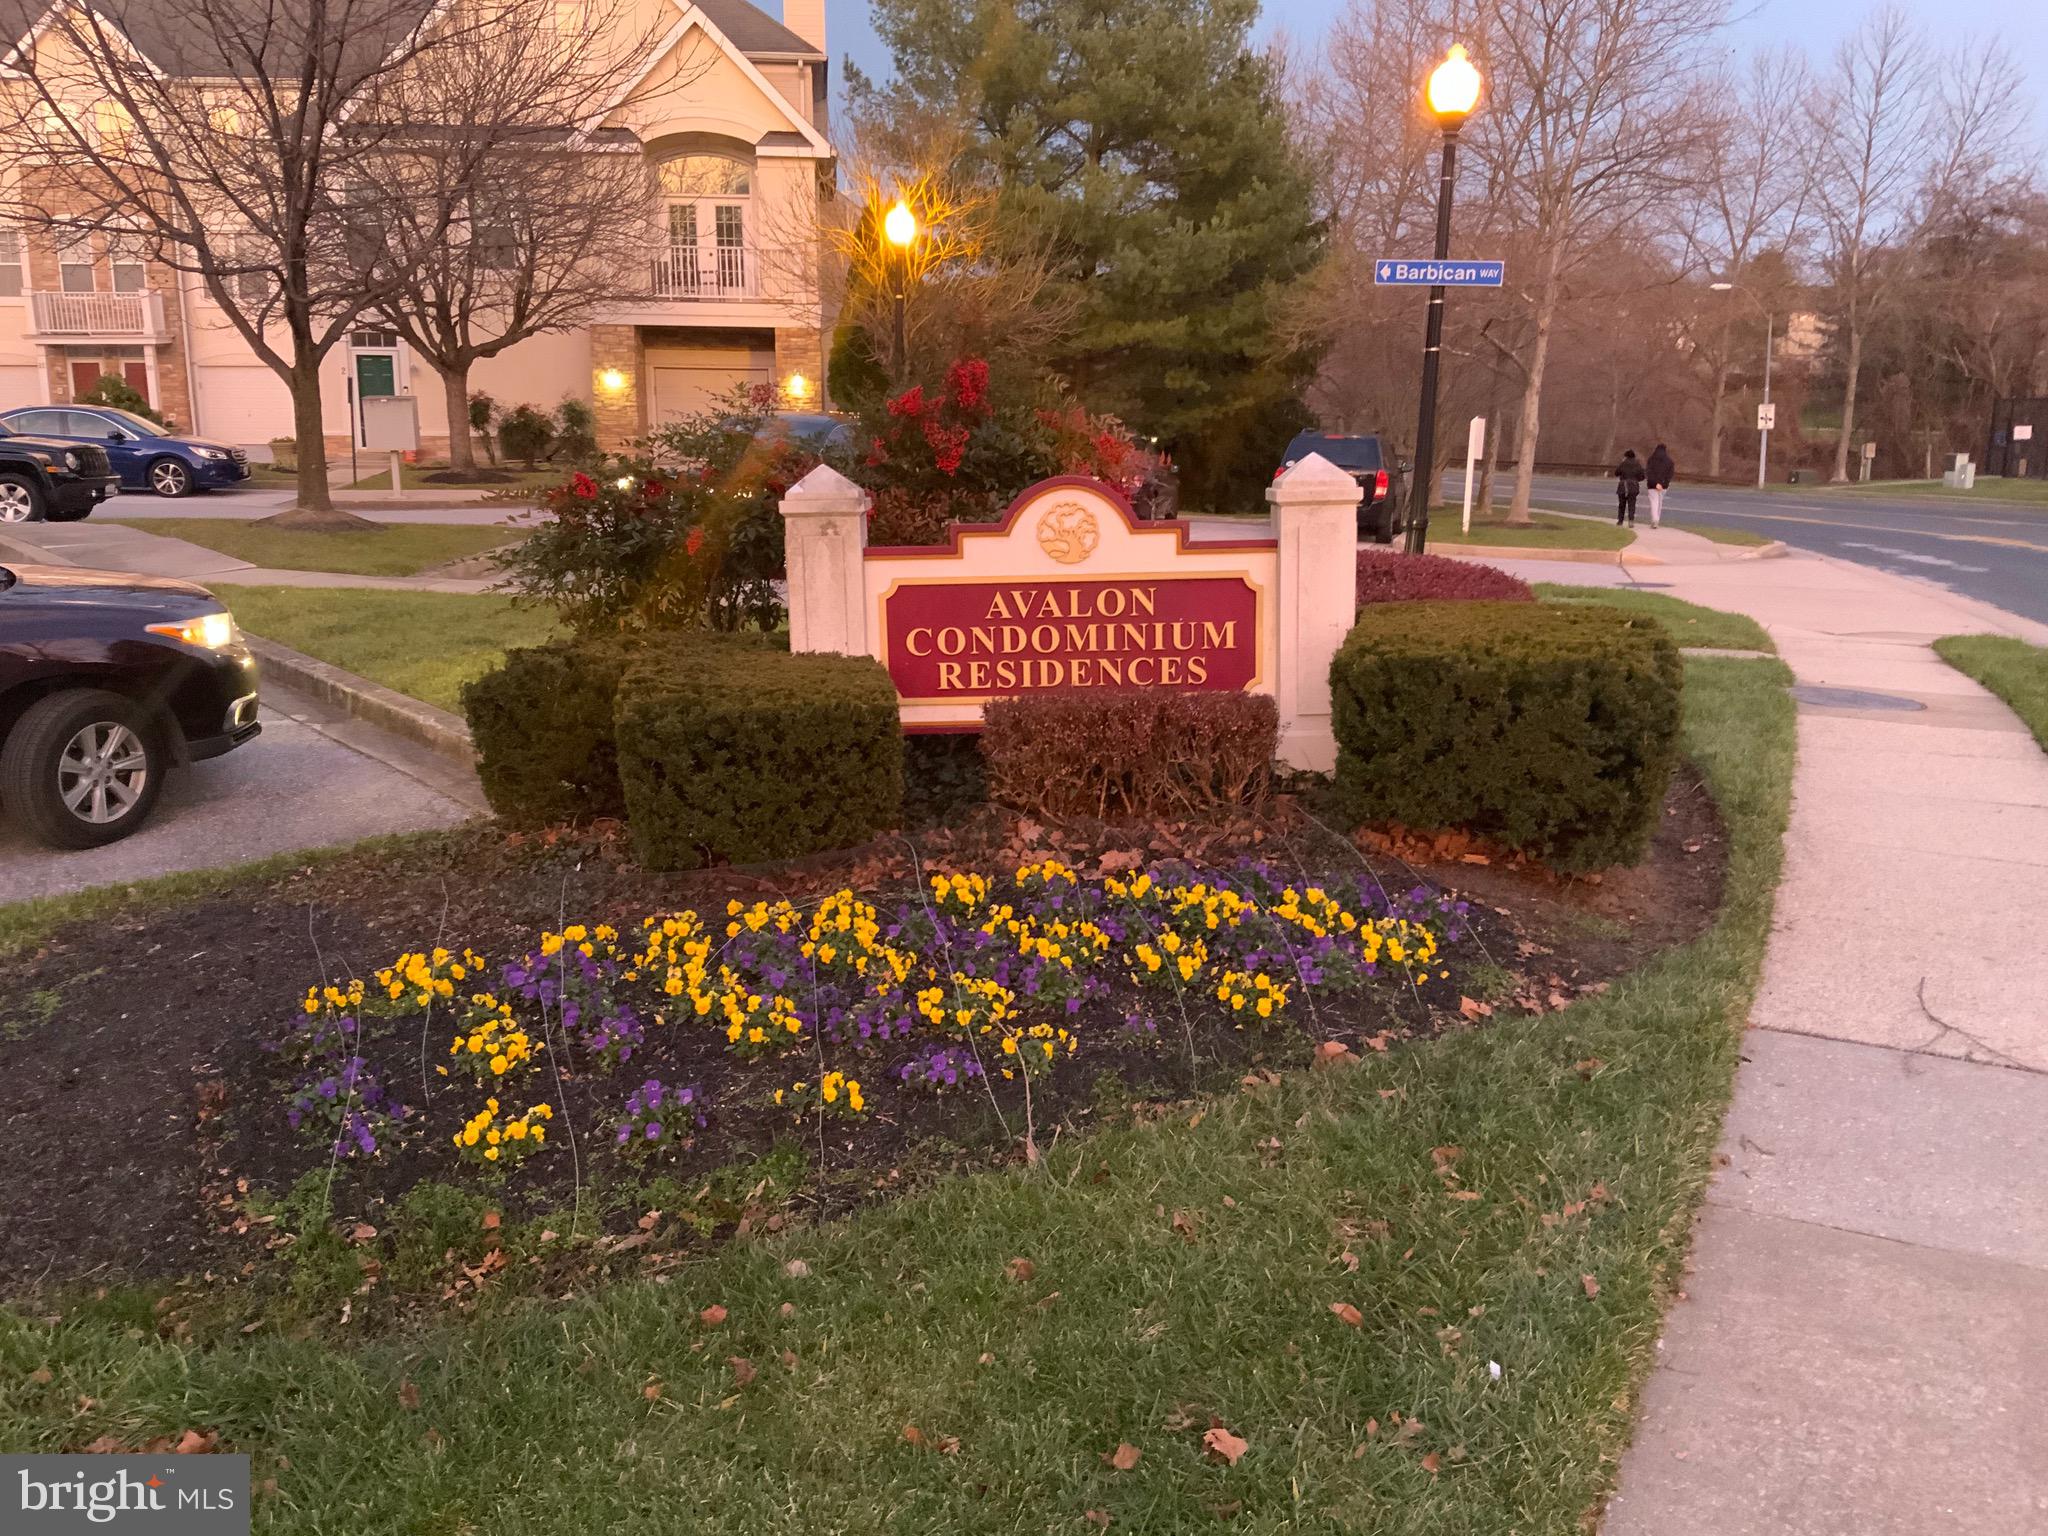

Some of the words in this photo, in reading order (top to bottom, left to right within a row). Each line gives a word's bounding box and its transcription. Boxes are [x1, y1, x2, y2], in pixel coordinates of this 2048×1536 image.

[1396, 264, 1476, 280] Barbican
[1480, 268, 1500, 279] WAY
[985, 587, 1157, 619] AVALON
[906, 620, 1237, 656] CONDOMINIUM
[937, 656, 1208, 690] RESIDENCES
